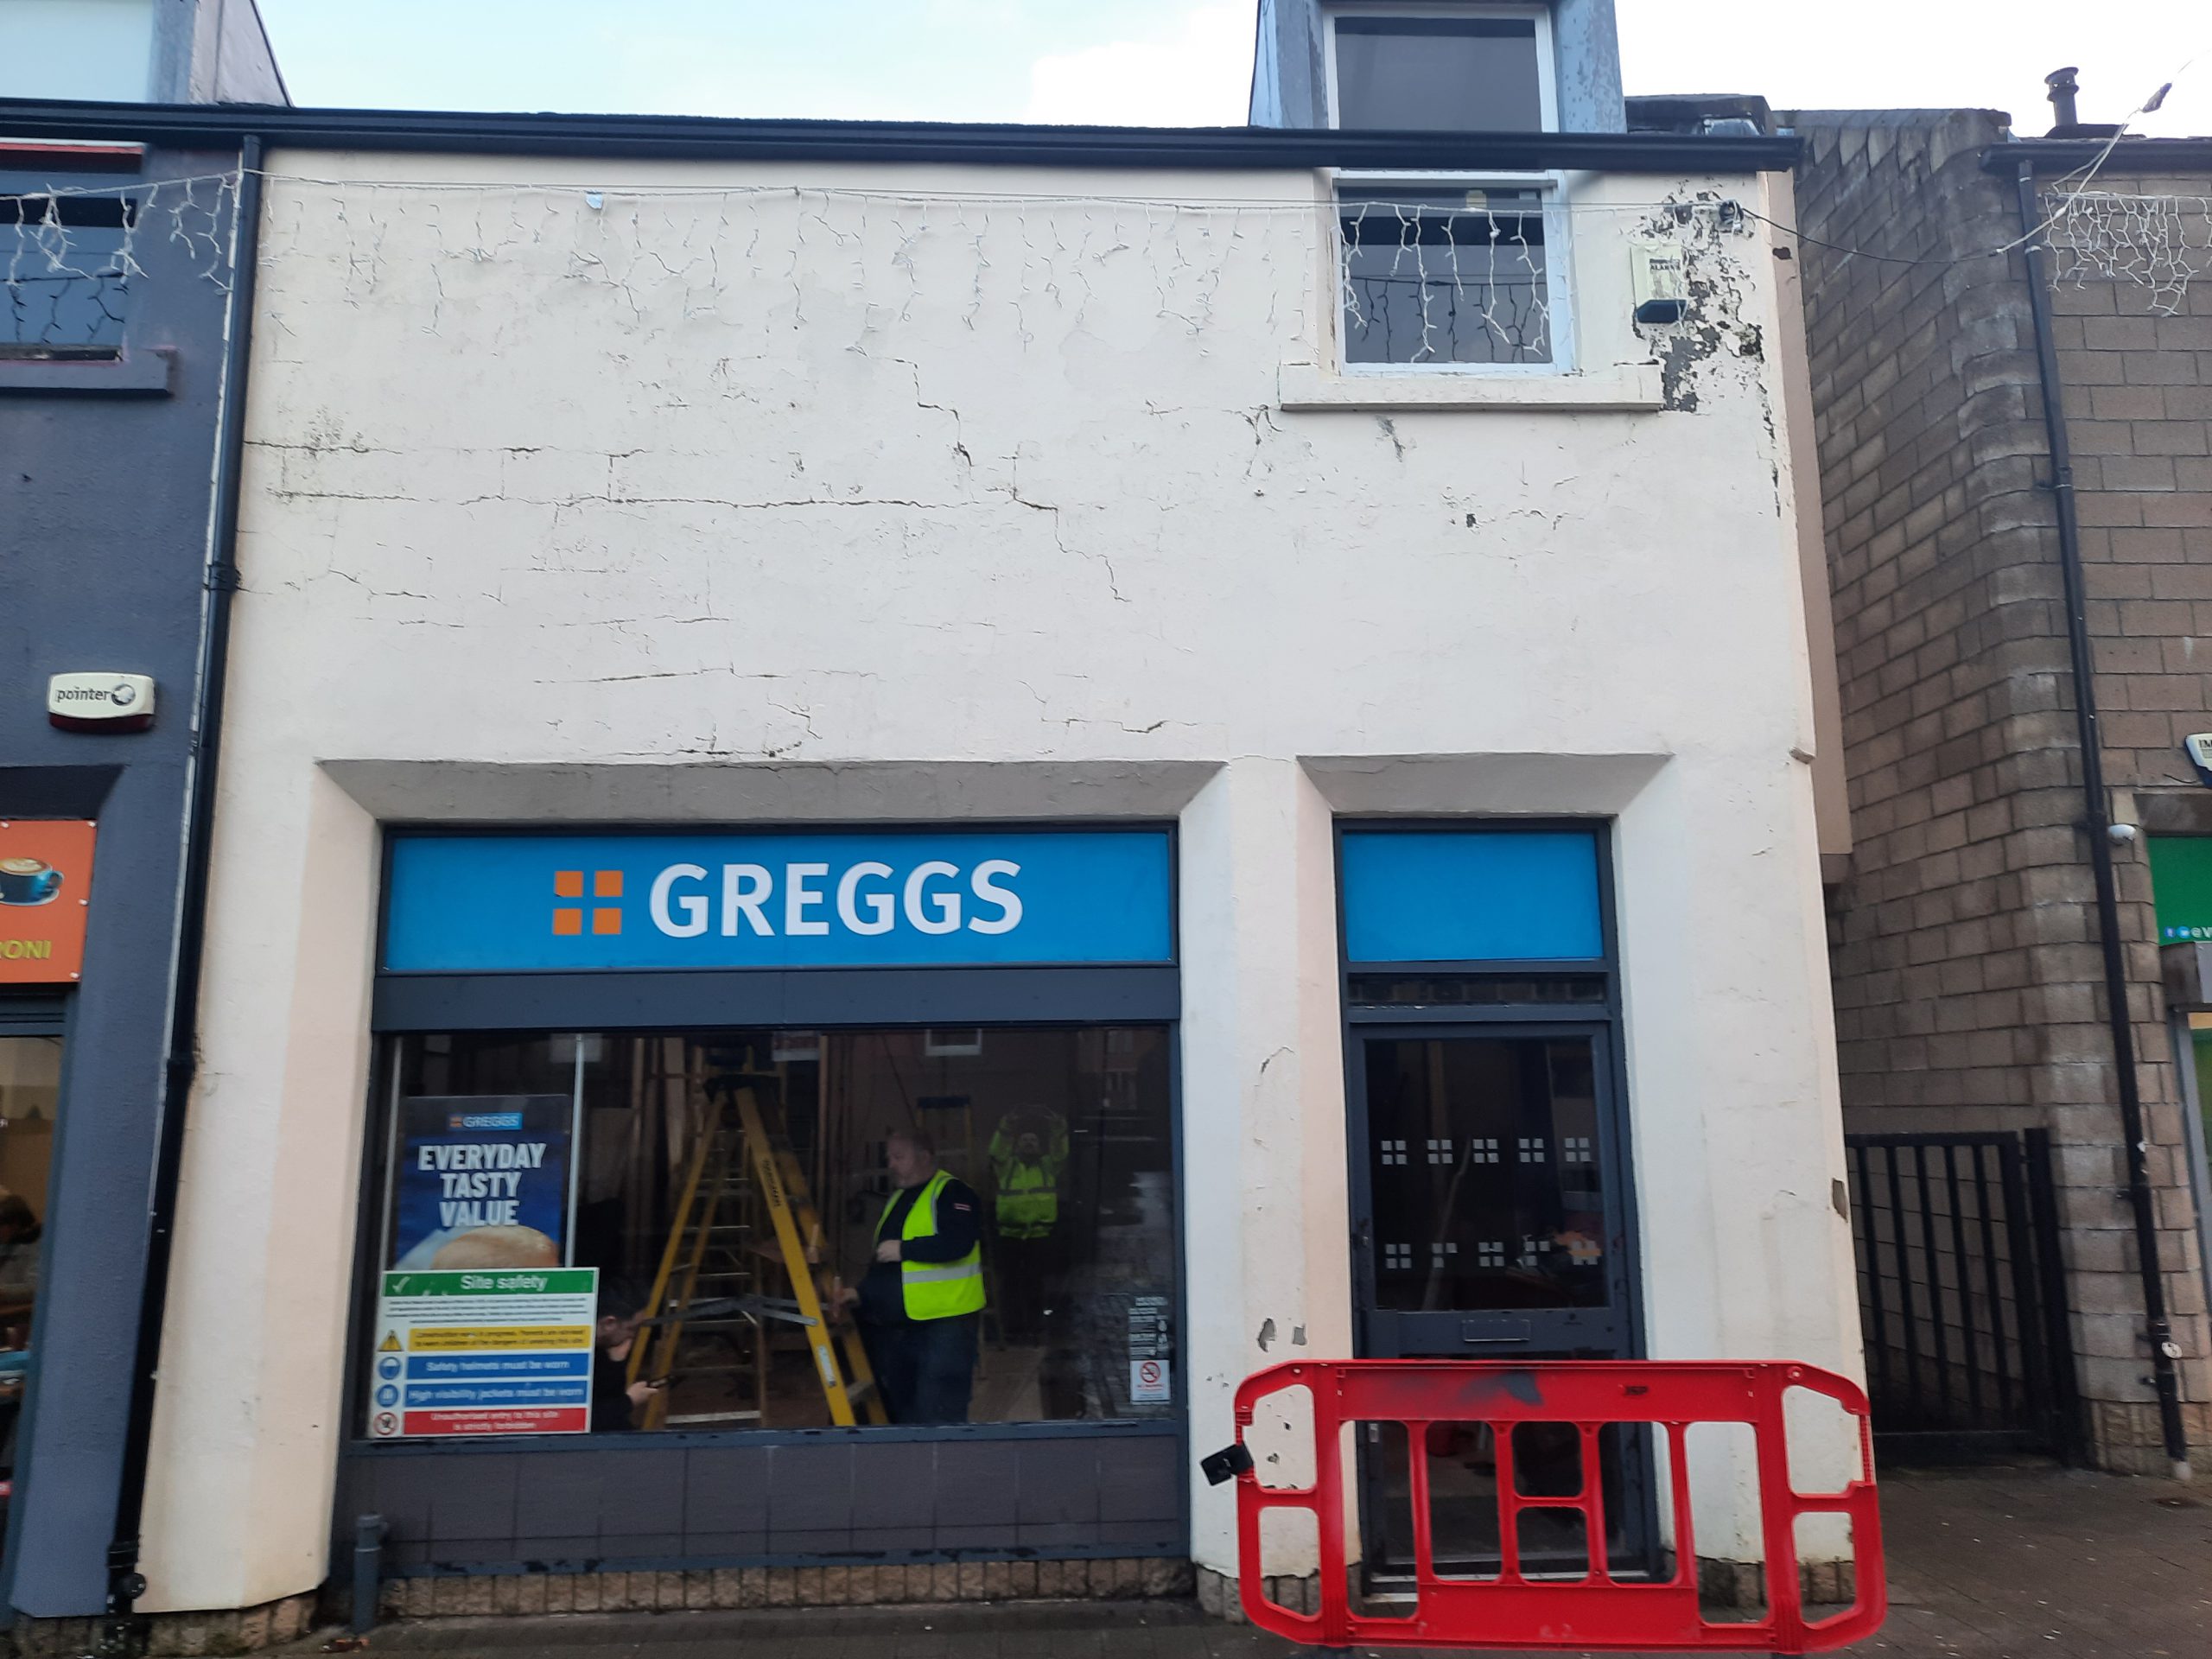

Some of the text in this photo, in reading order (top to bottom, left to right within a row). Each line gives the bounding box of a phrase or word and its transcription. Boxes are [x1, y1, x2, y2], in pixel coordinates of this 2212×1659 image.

[55, 686, 111, 702] pointer
[650, 859, 1023, 938] GREGGS
[463, 1116, 519, 1128] GREGGS
[418, 1143, 547, 1171] EVERYDAY
[439, 1172, 522, 1198] TASTY
[439, 1199, 520, 1227] VALUE
[461, 1274, 548, 1292] Site safety
